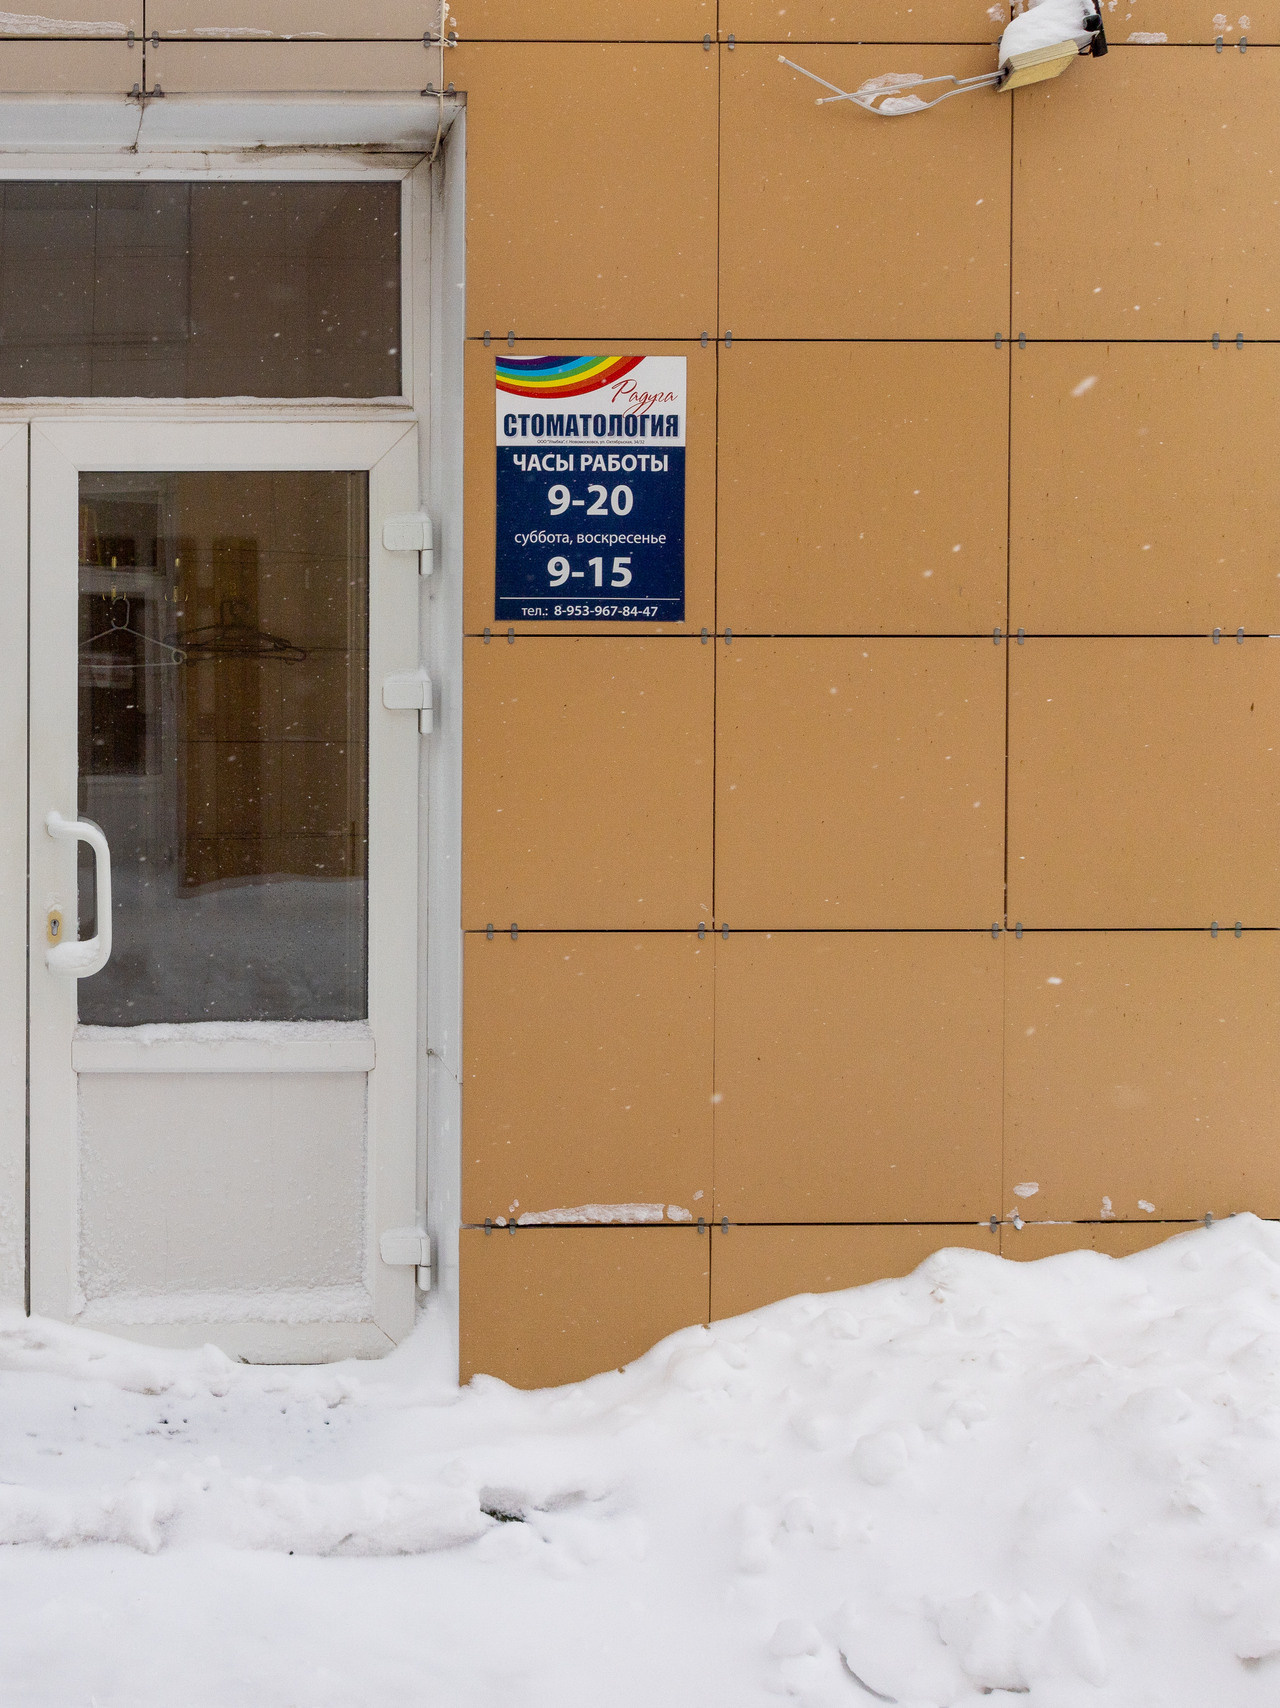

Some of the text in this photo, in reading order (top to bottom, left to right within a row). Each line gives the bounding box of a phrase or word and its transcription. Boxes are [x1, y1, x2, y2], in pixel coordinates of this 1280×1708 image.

[611, 379, 678, 418] Радуга
[503, 414, 679, 437] СТОМАТОЛОГИЯ
[513, 454, 669, 472] ЧАСЫ РАБОТЫ
[547, 484, 634, 516] 9-20
[514, 530, 667, 547] суббота, воскресенье
[547, 556, 632, 588] 9-15
[521, 605, 659, 617] тел.: 8-953-967-84-47
